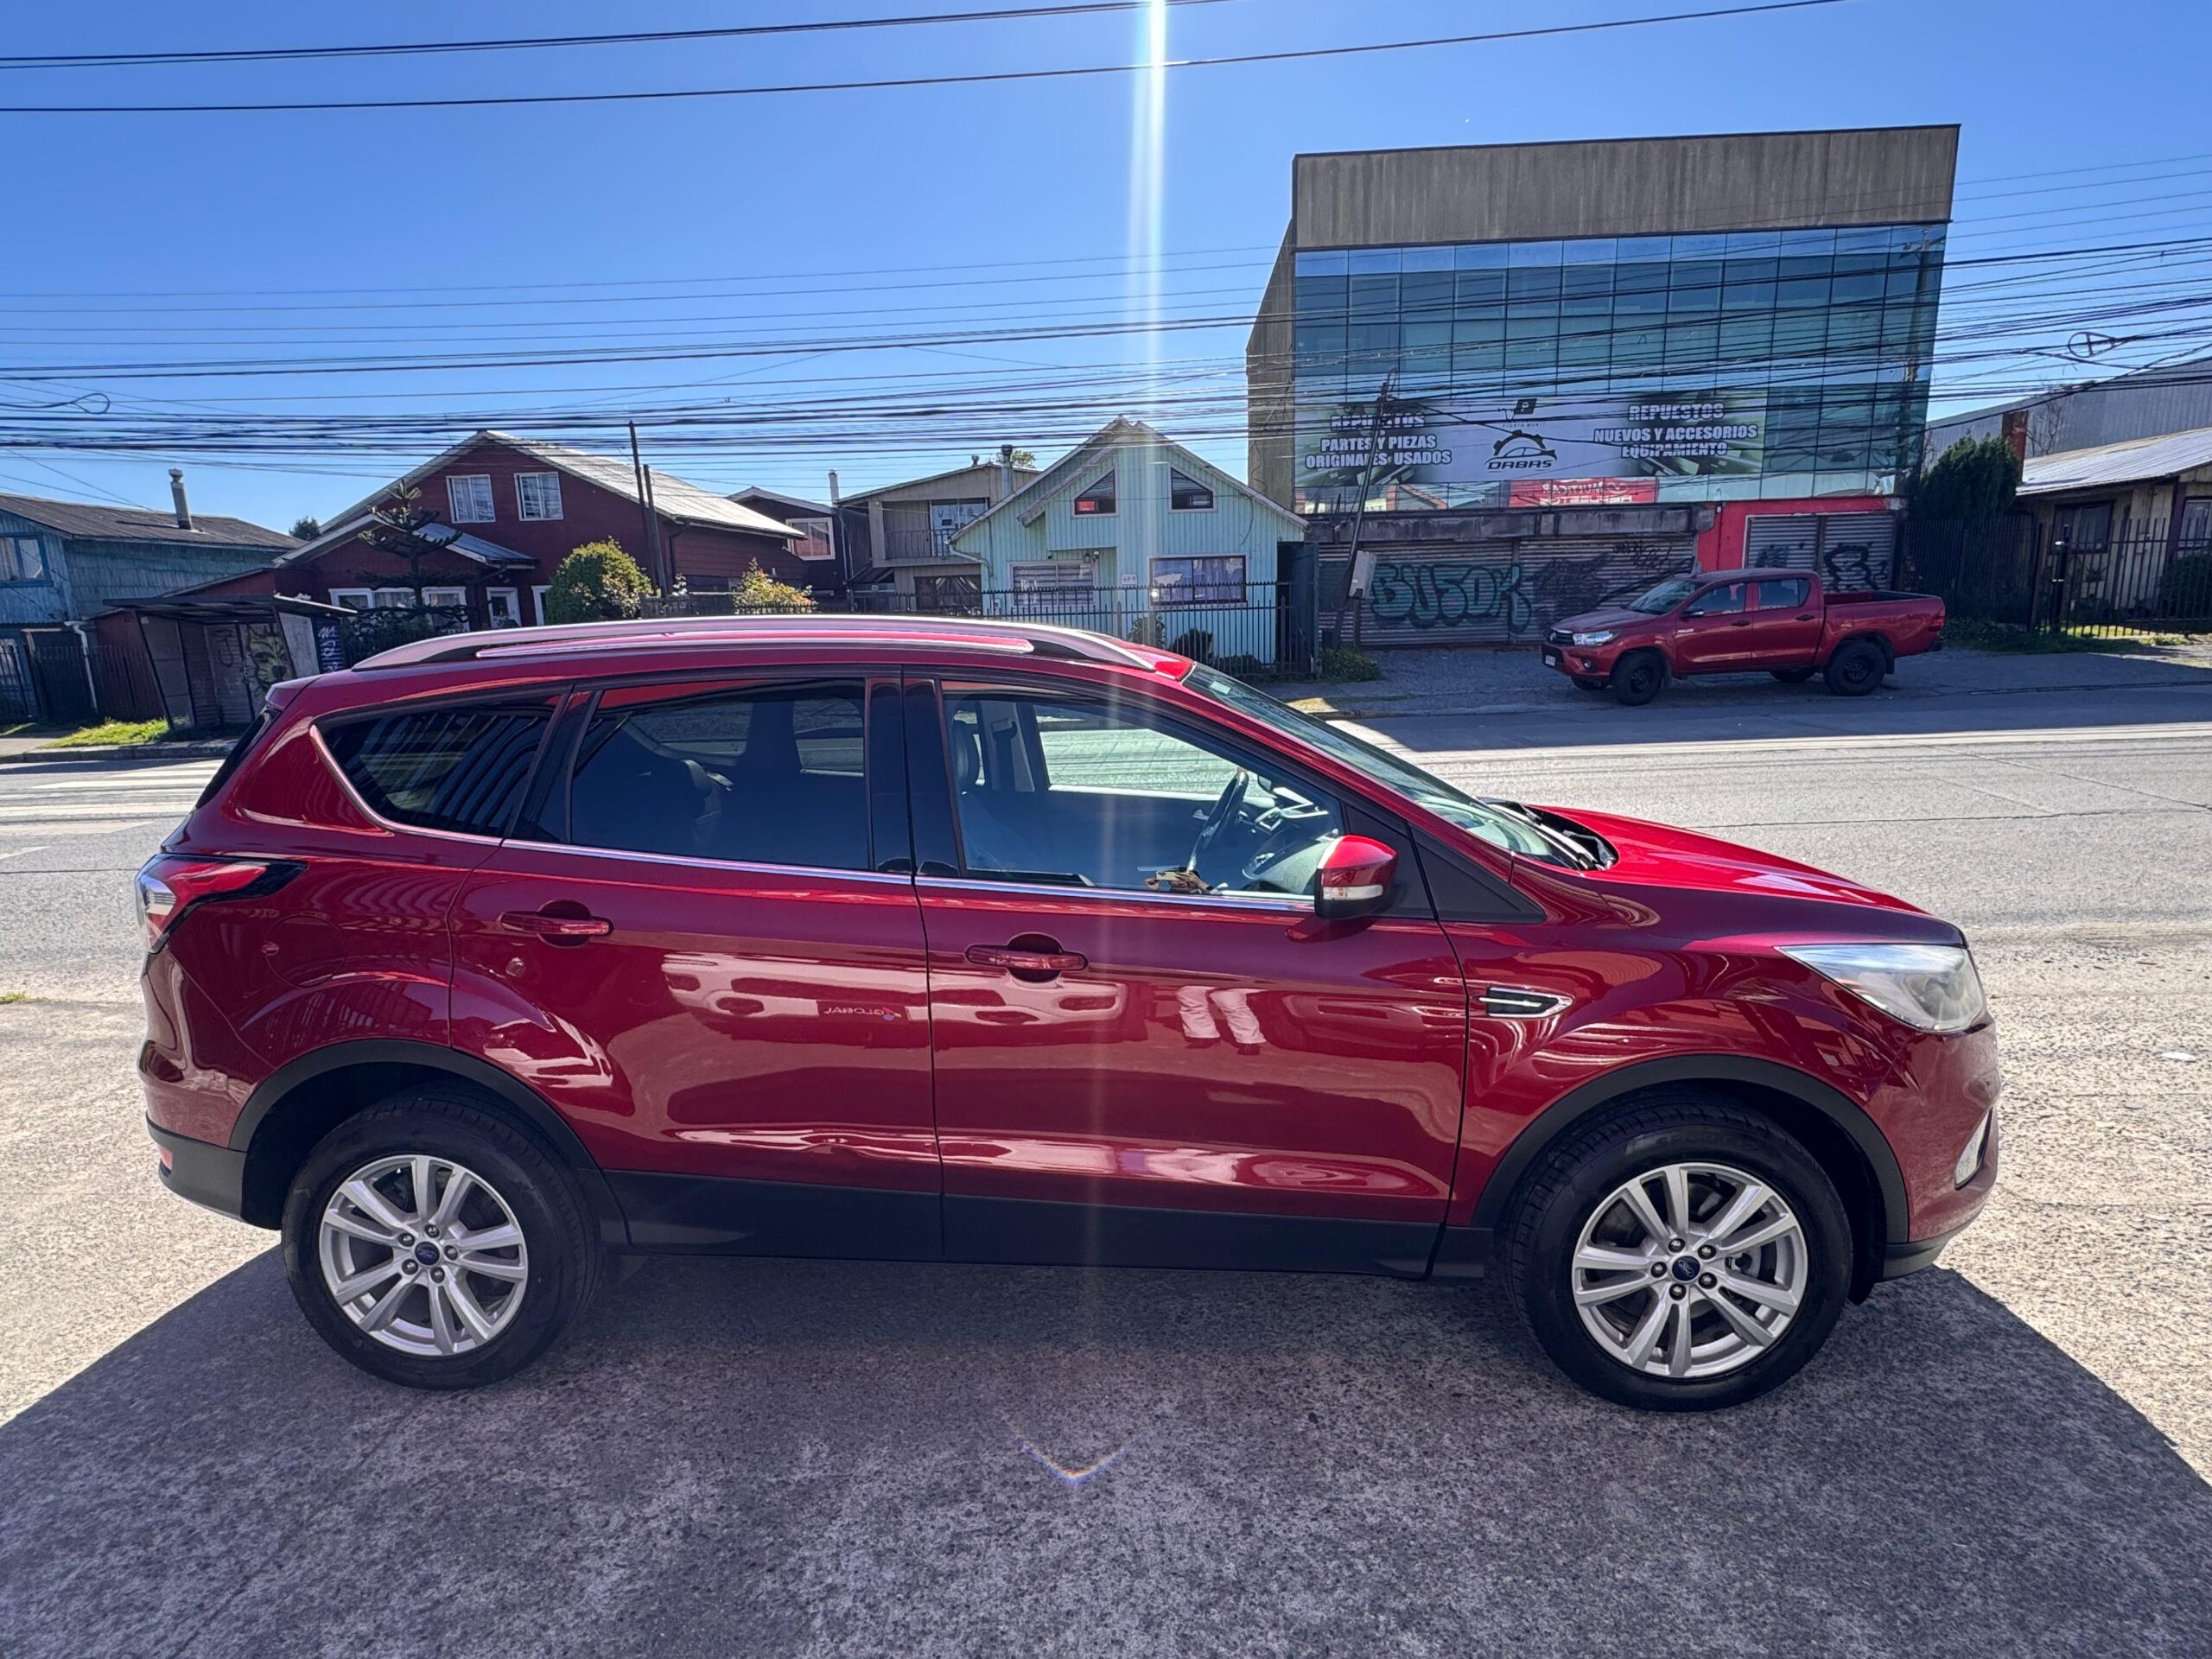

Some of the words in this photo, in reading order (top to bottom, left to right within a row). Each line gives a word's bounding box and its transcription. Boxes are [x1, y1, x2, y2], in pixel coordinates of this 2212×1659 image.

[1628, 404, 1724, 421] REPUESTOS
[1594, 429, 1651, 442] NUEVOS
[1654, 429, 1664, 441] Y
[1665, 425, 1758, 441] ACCESORIOS
[1321, 437, 1372, 451] PARTES
[1377, 436, 1386, 449] Y
[1389, 435, 1436, 449] PIEZAS
[1622, 442, 1727, 458] EQUIPAMIENTO
[1394, 450, 1452, 465] USADOS
[1487, 460, 1553, 470] DABAS
